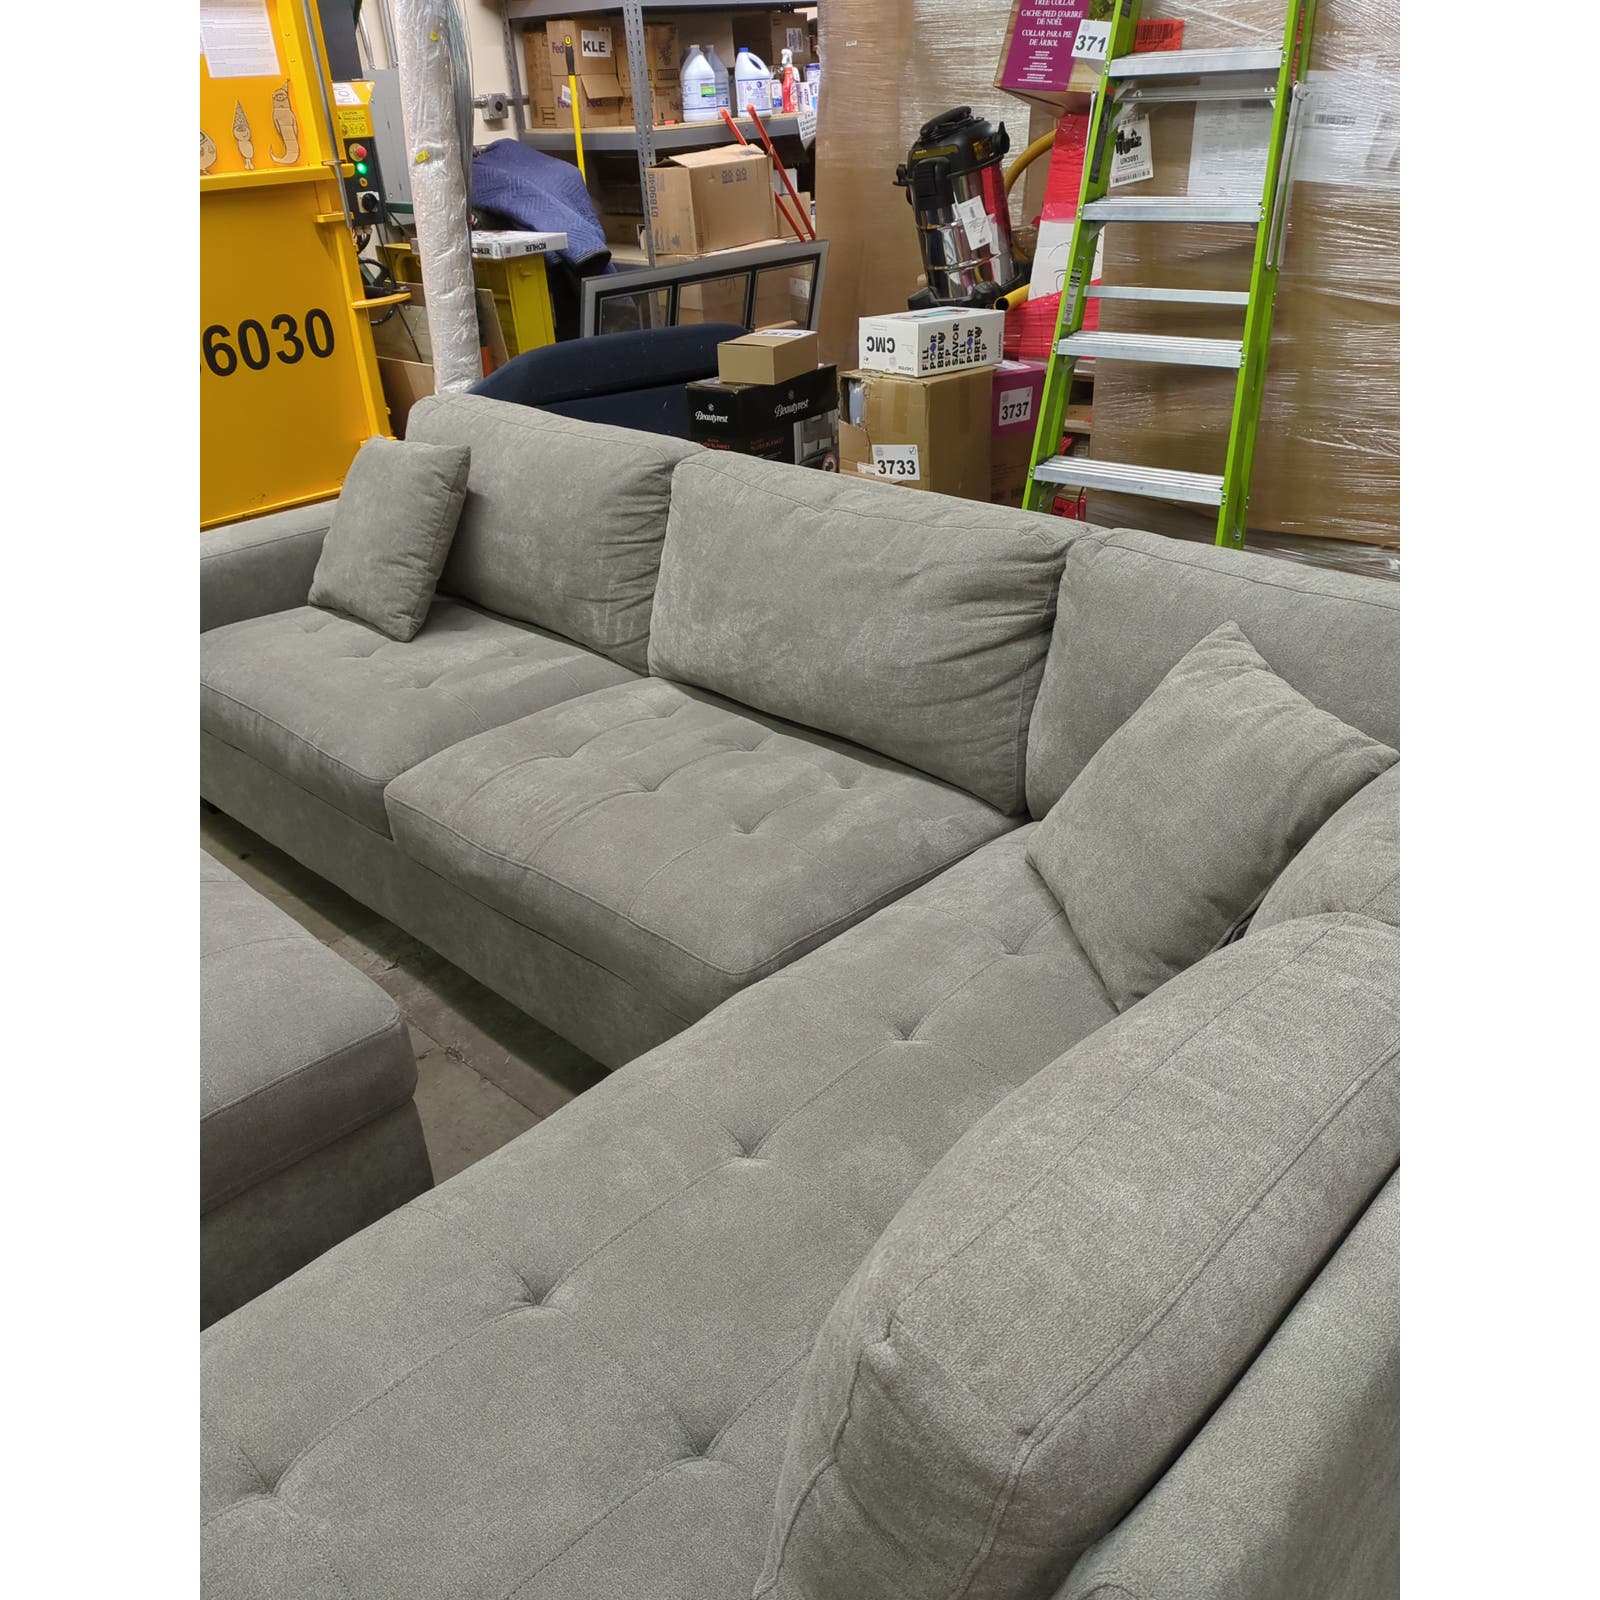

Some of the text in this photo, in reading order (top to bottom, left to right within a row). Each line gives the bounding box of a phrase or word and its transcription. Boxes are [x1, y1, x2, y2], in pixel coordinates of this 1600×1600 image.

[1021, 9, 1057, 17] CACHE-PIED
[1046, 17, 1062, 26] NOËL
[1021, 29, 1045, 37] COLLAR
[583, 41, 606, 53] KLE
[1075, 35, 1107, 53] 371
[200, 308, 335, 377] 6030
[866, 336, 896, 354] CMC
[937, 332, 946, 368] BREW
[952, 322, 960, 366] SAVOR
[974, 326, 982, 362] BREW
[694, 410, 728, 424] Beautyrest
[774, 399, 809, 418] Beautyrest
[1001, 401, 1030, 421] 3737
[877, 459, 916, 475] 3733
